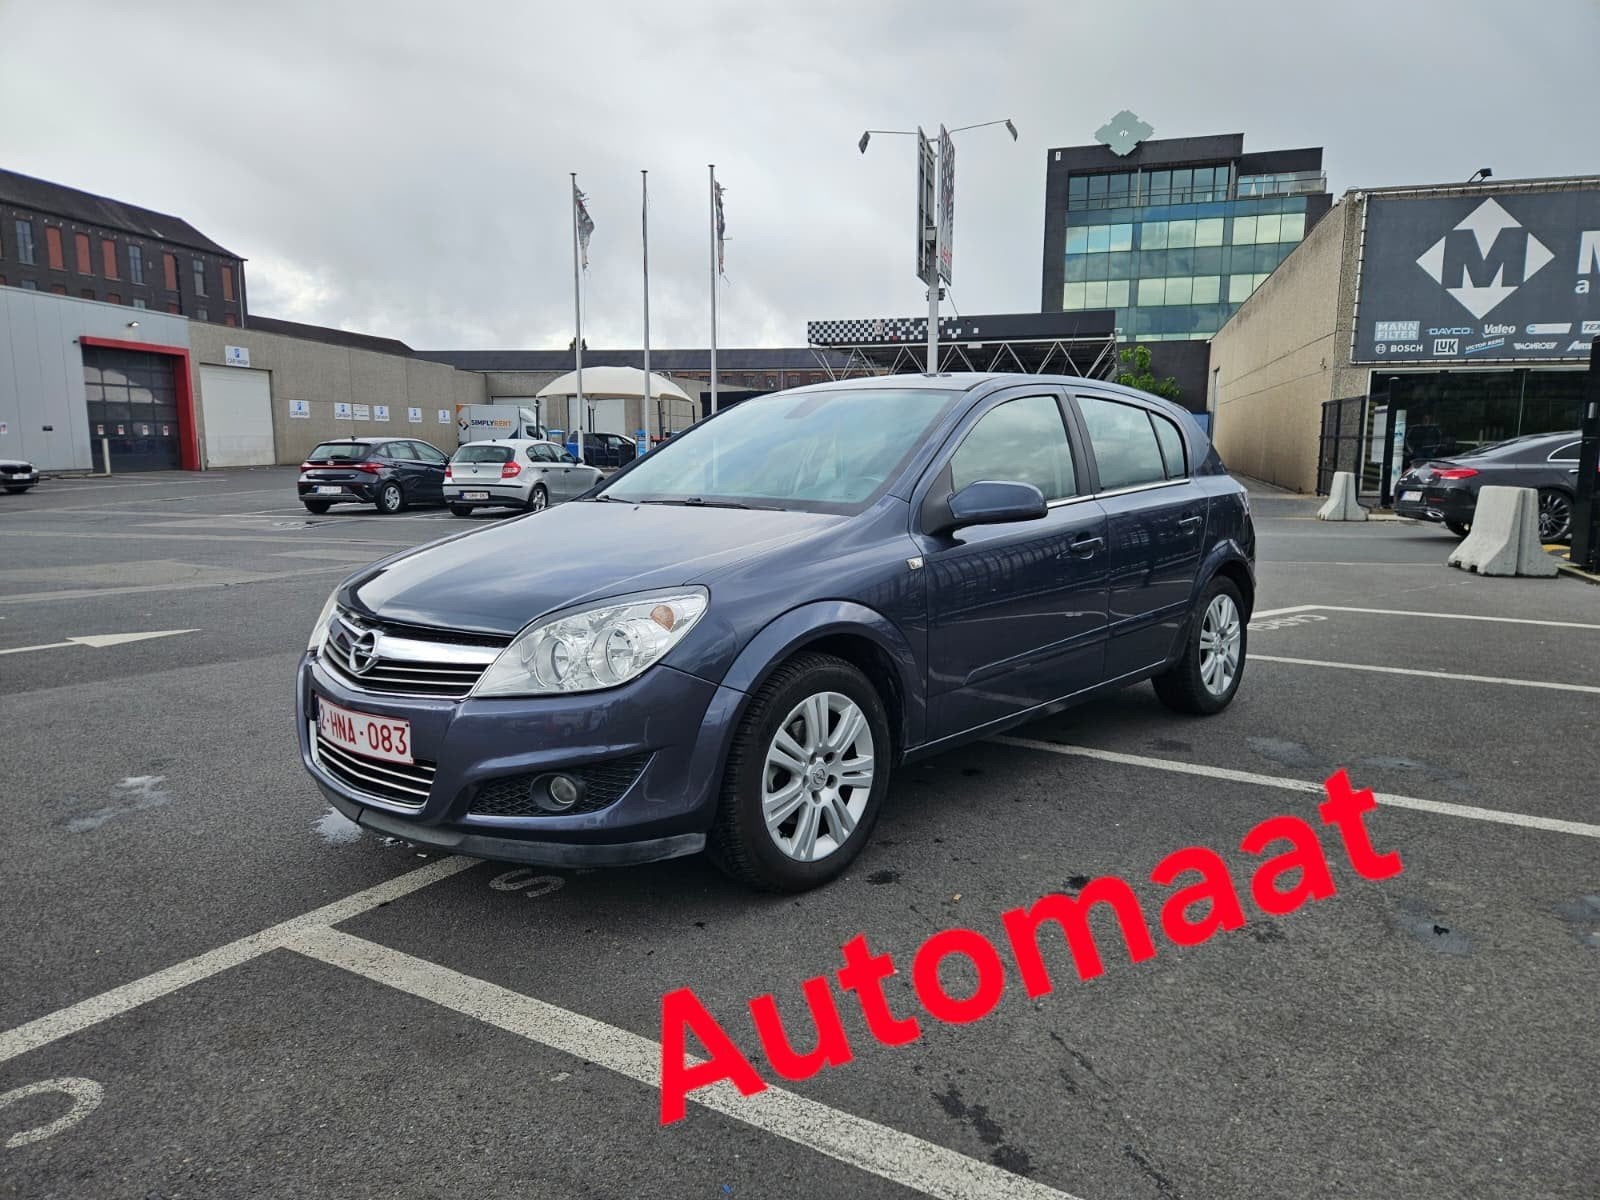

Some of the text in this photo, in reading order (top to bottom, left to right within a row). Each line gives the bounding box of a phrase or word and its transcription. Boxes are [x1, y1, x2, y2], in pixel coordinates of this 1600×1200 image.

[1378, 322, 1417, 331] MANN
[1484, 323, 1516, 334] Valeo
[1377, 330, 1417, 340] FILTER
[1429, 327, 1471, 336] DAYCO
[1390, 344, 1424, 353] BOSCH
